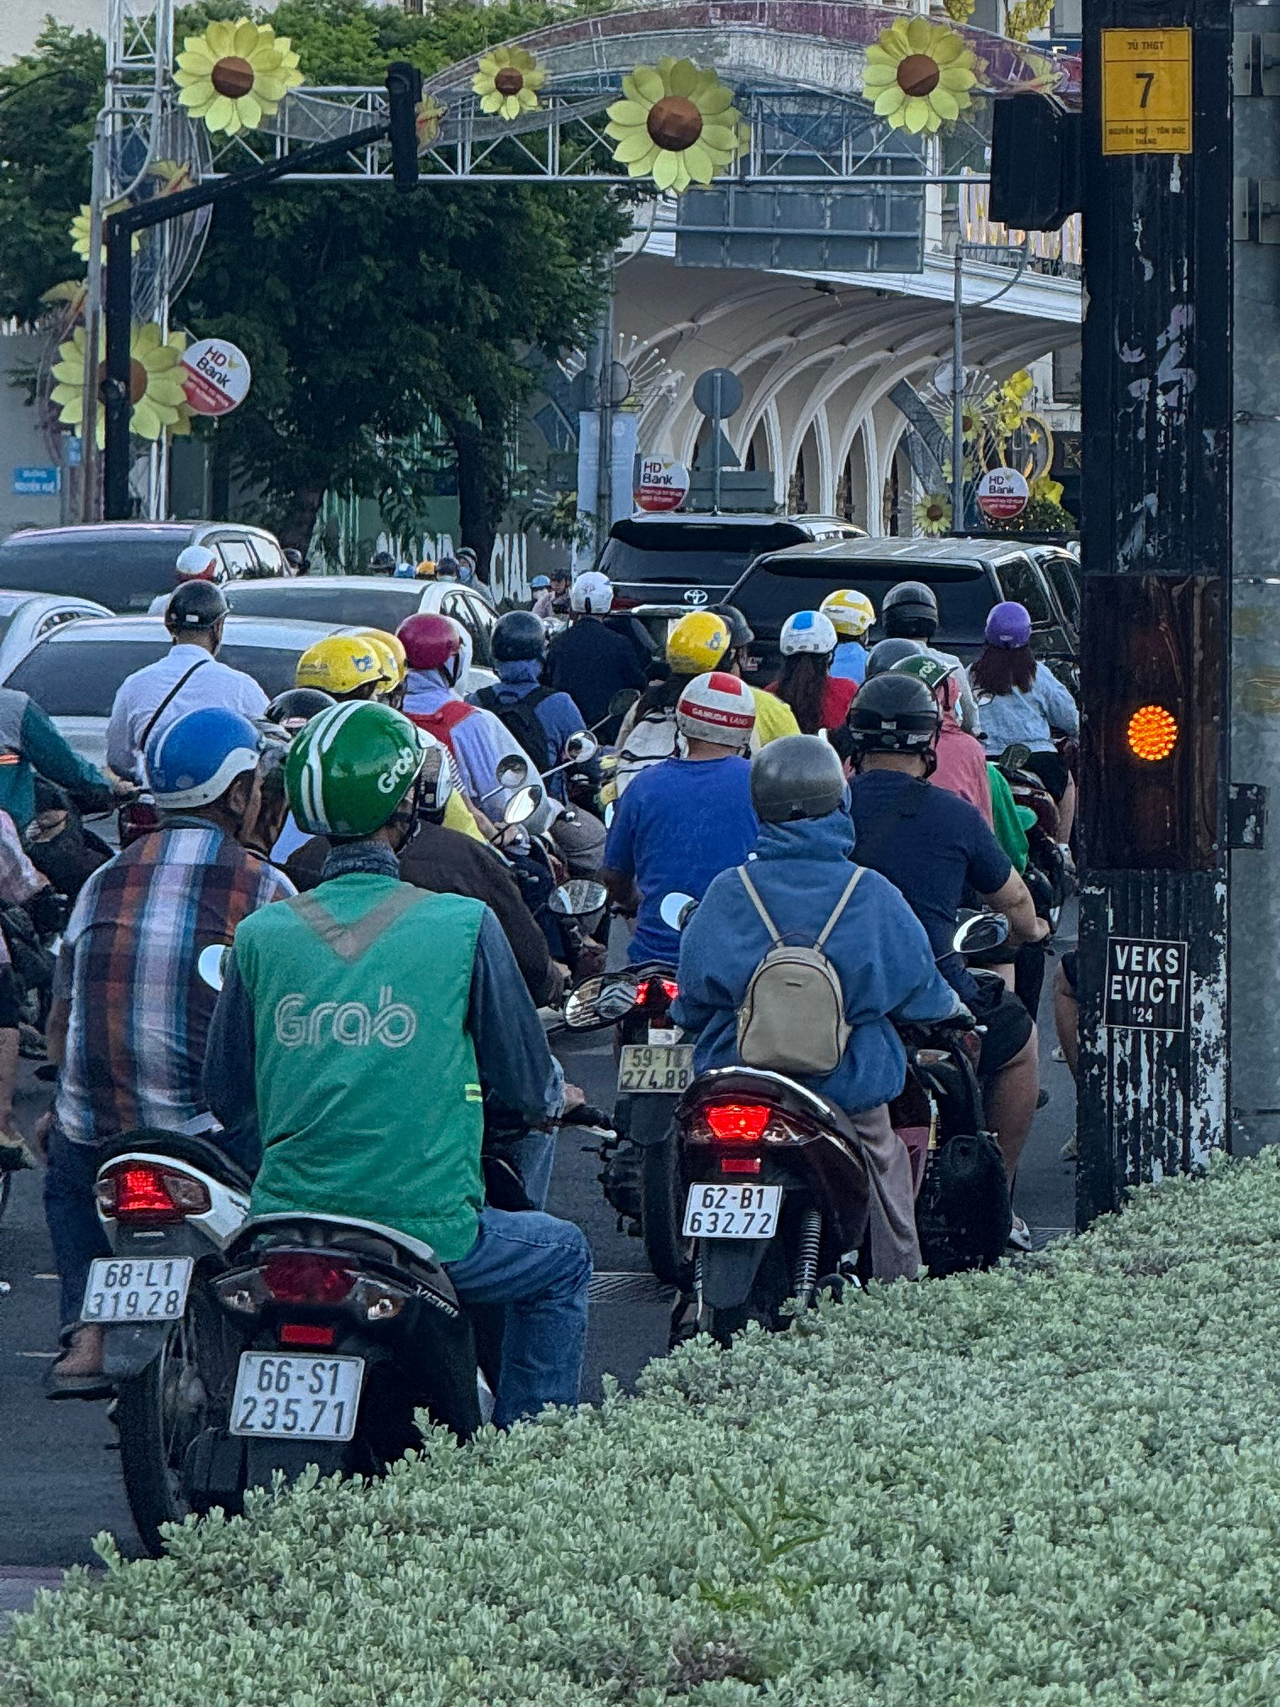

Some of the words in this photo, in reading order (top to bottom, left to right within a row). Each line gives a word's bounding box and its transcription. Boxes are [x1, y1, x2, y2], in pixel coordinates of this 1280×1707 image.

[1142, 41, 1164, 50] THGT
[1135, 72, 1155, 108] 7
[204, 346, 227, 367] HD
[196, 356, 231, 388] Bank
[642, 472, 672, 485] Bank
[643, 461, 661, 473] HD
[989, 475, 1004, 485] HD
[989, 485, 1014, 494] Bank
[377, 747, 414, 794] Grab
[1115, 944, 1179, 974] VEKS
[1111, 975, 1181, 1005] EVICT
[275, 986, 416, 1048] Grab
[701, 1187, 764, 1210] 62-B1
[689, 1211, 772, 1234] 632.72
[104, 1262, 174, 1288] 68-L1
[85, 1290, 180, 1318] 319.28
[257, 1359, 340, 1396] 66-S1
[239, 1396, 346, 1434] 235.71
